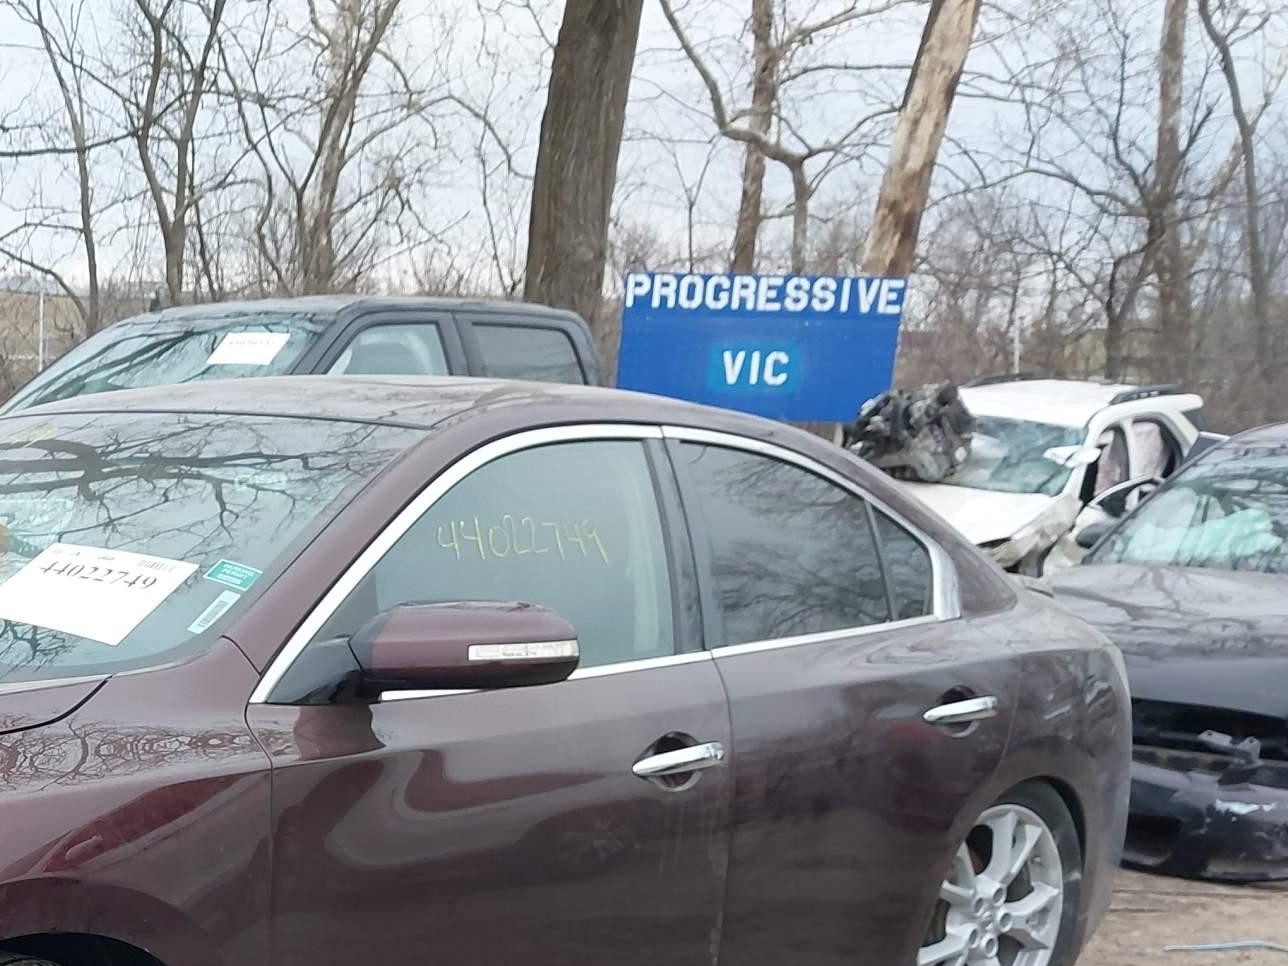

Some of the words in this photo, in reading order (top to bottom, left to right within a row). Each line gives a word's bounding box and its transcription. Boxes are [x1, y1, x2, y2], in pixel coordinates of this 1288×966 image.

[625, 272, 905, 315] PROGRESSIVE
[723, 350, 790, 386] VIC
[437, 514, 611, 568] 44022749
[39, 560, 158, 590] 44022749
